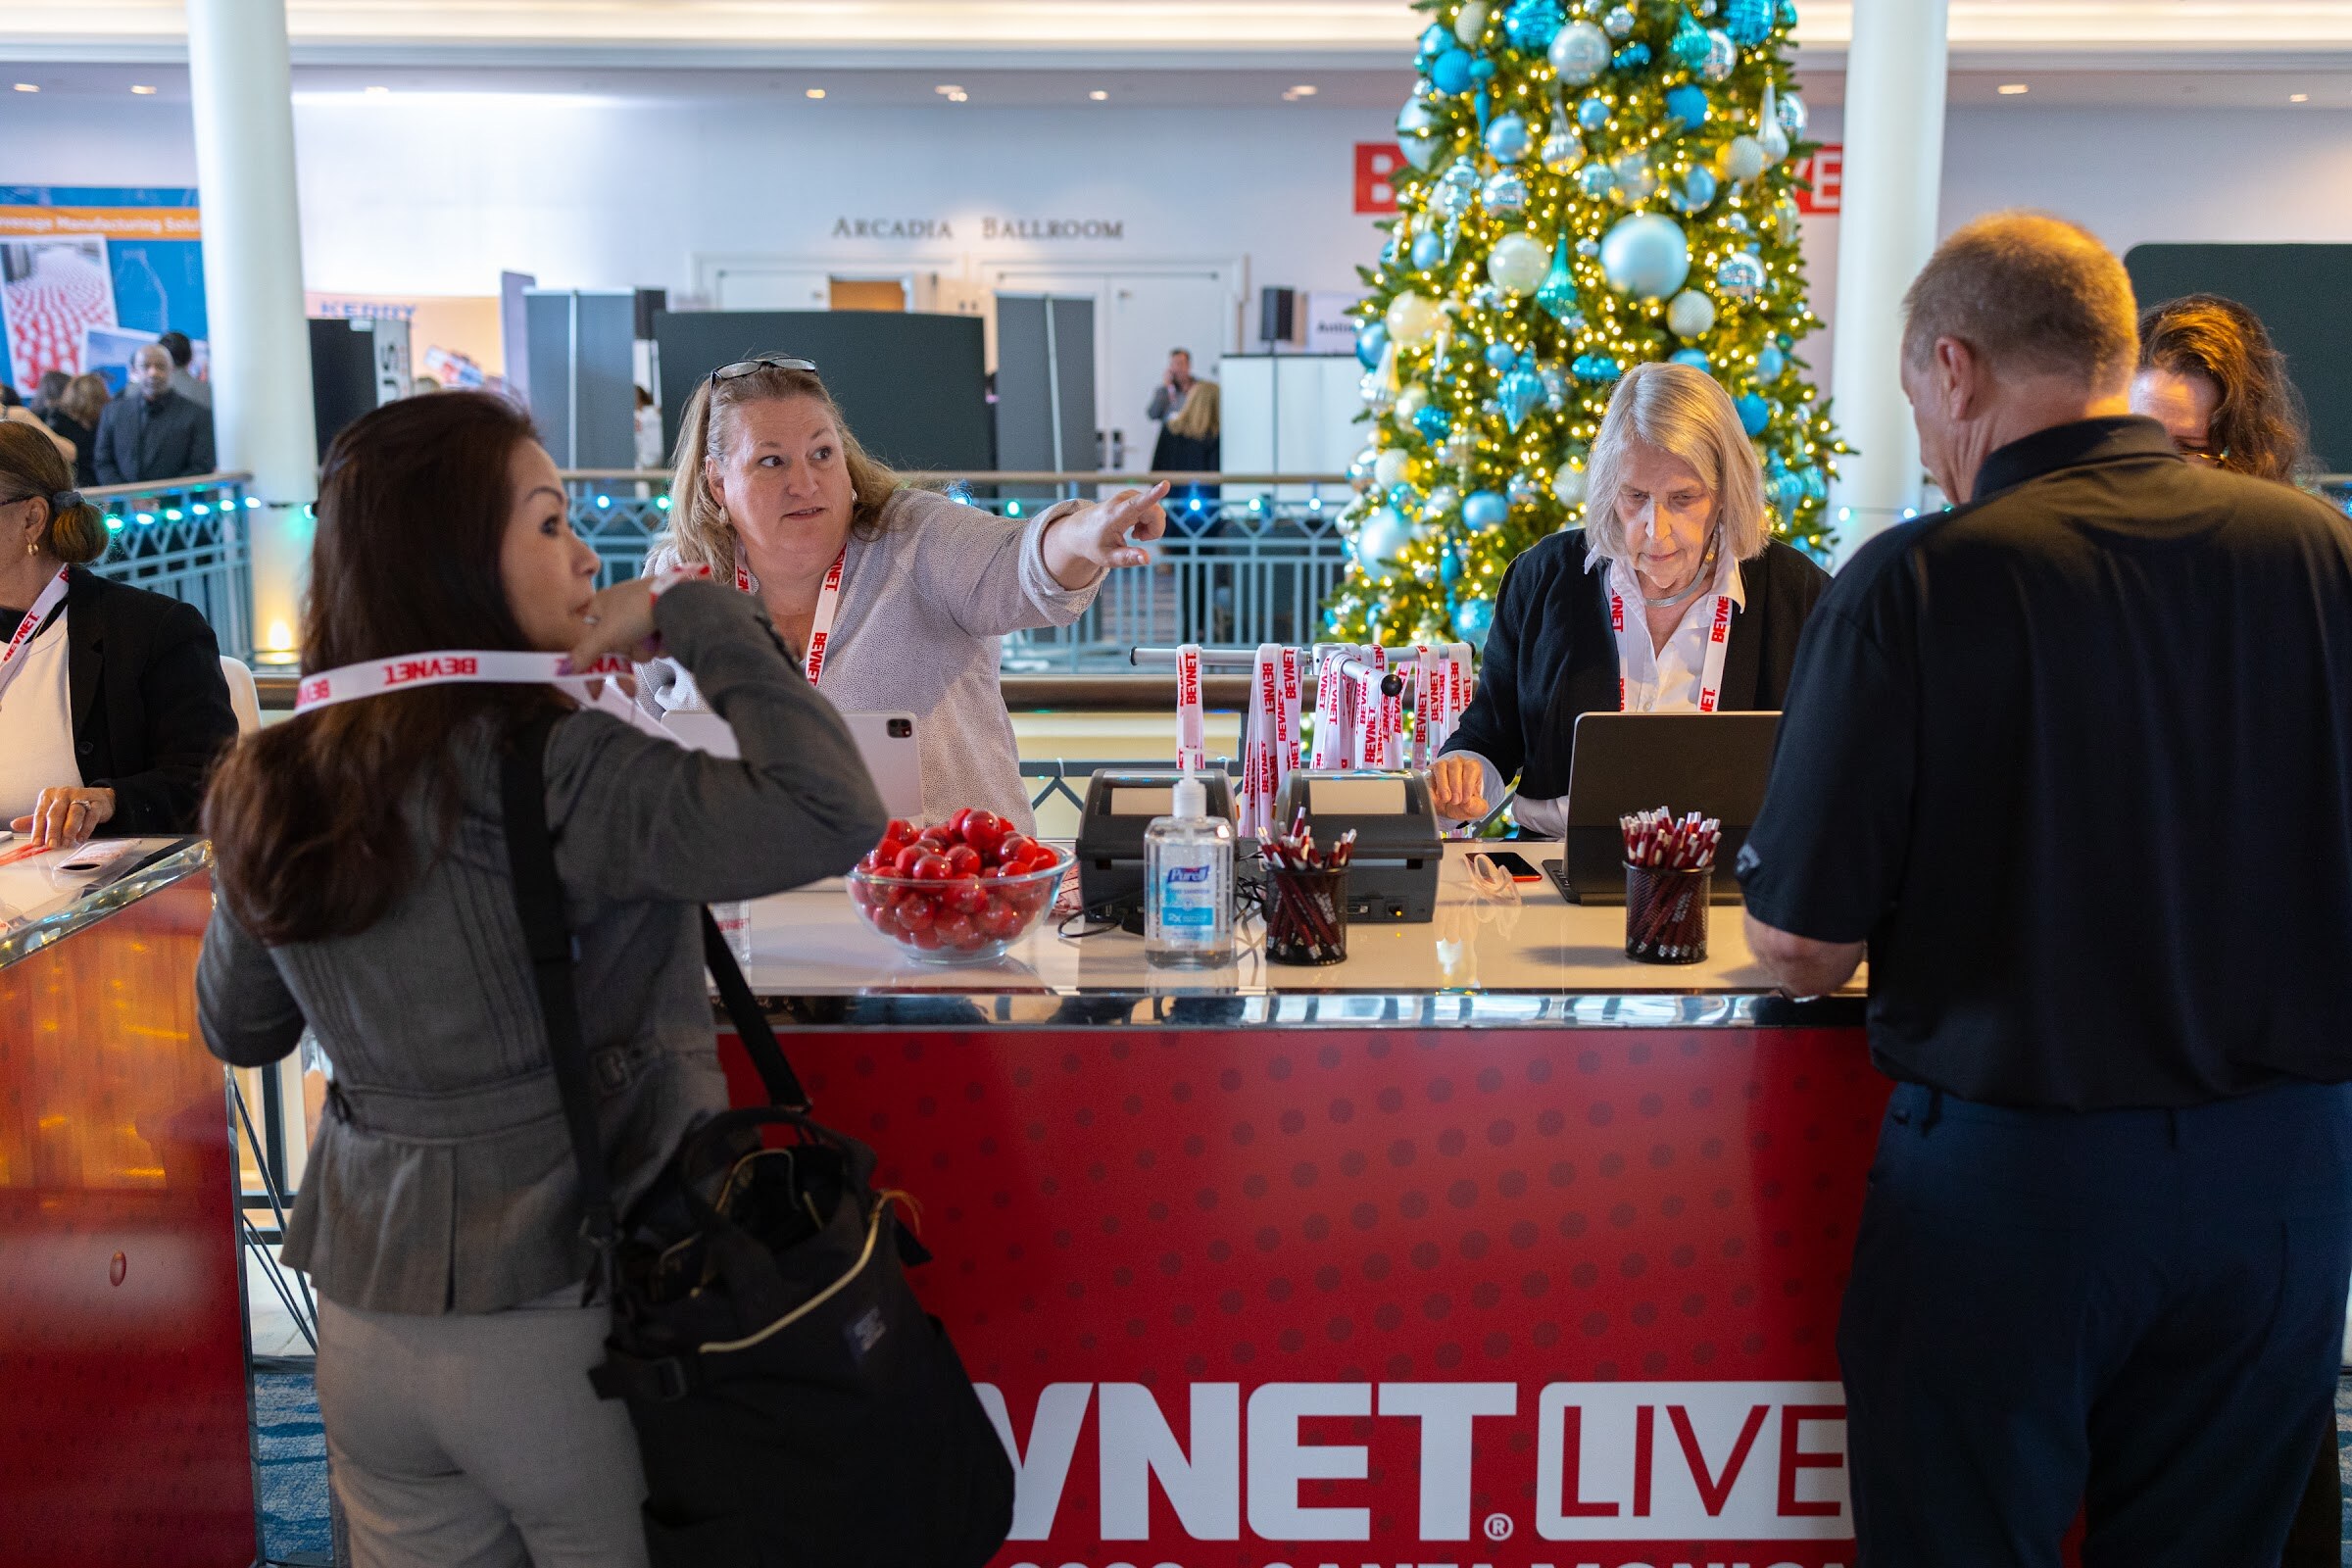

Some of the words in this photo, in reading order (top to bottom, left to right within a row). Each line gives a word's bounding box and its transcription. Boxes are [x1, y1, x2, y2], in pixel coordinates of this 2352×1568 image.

[833, 217, 953, 238] ARCADIA
[982, 217, 1124, 238] BALLROOM
[382, 657, 478, 686] BEVNET
[1185, 653, 1197, 705] BEVNET
[1262, 662, 1276, 716] BEVNET
[1283, 648, 1298, 700] BEVNET
[1430, 670, 1439, 722] BEVNET
[1450, 662, 1461, 712] BEVNET
[1364, 706, 1377, 763] BEVNET
[1416, 692, 1428, 743] BEVNET
[1561, 1404, 1844, 1517] LIVE
